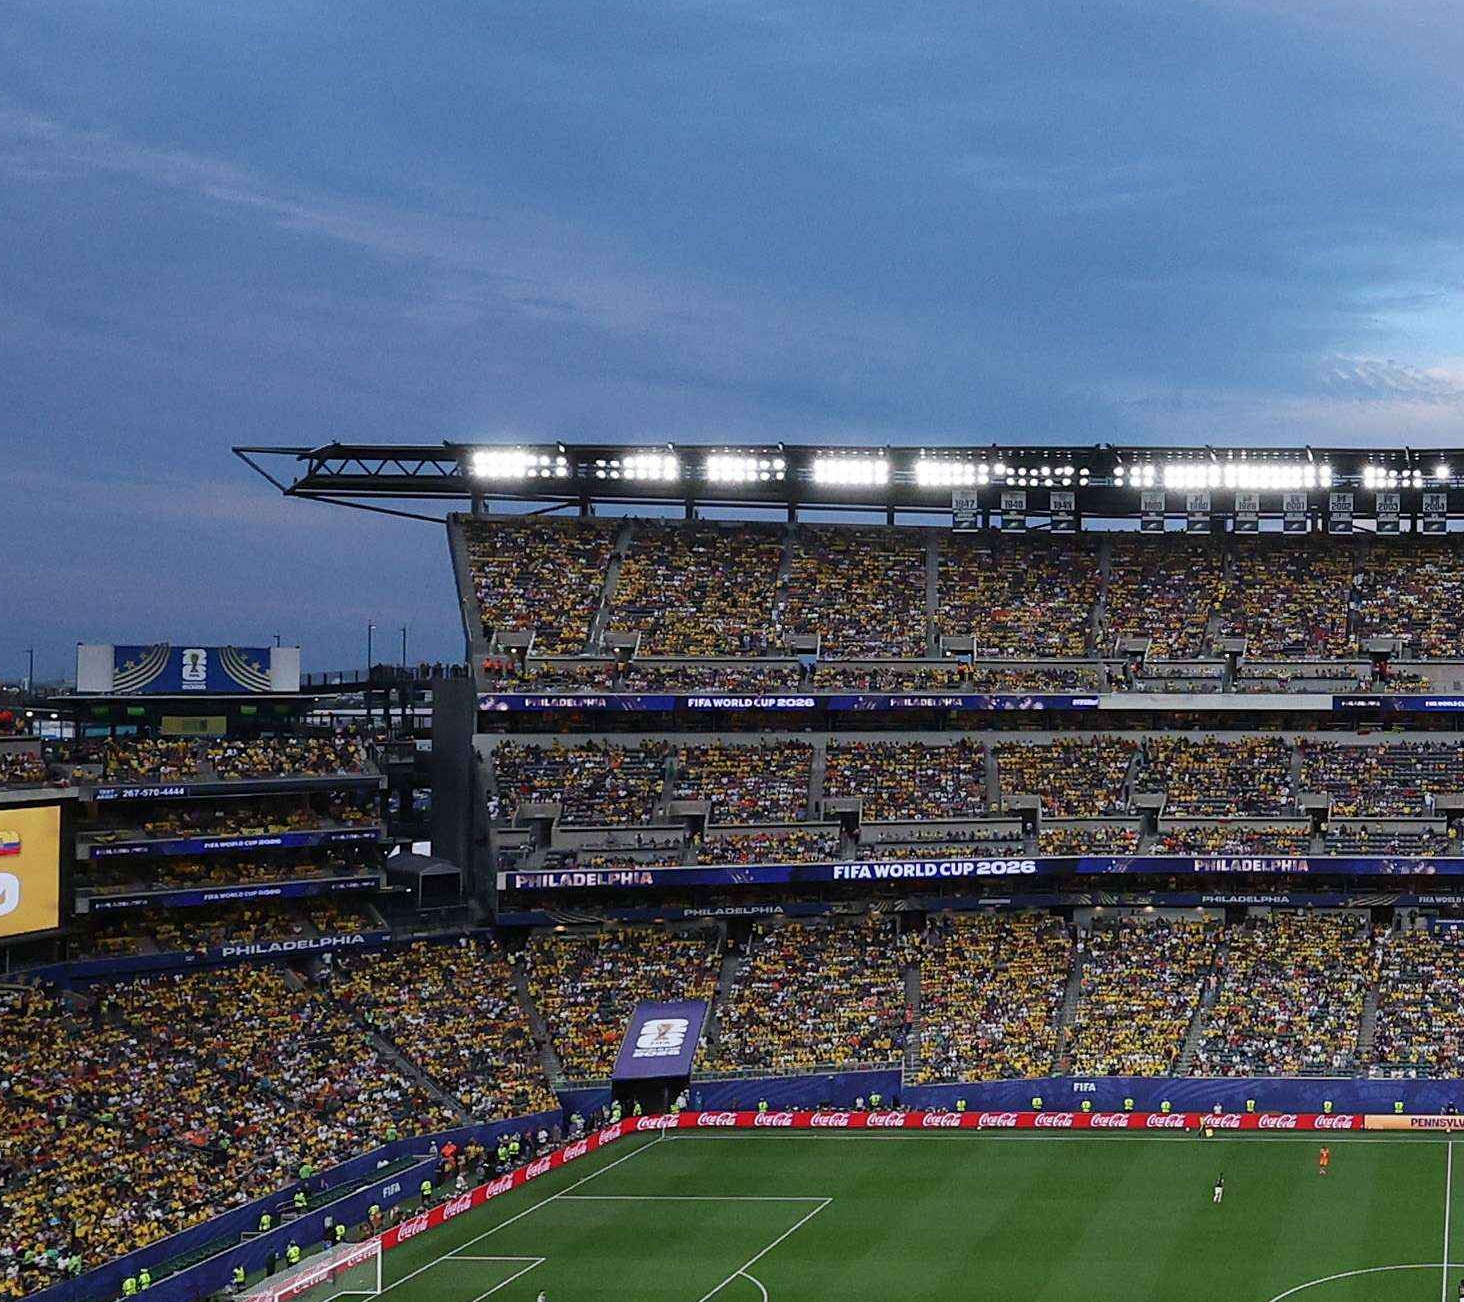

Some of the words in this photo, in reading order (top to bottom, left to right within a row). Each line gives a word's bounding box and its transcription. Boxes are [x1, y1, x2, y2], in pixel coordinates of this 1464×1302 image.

[688, 698, 710, 707] FIFA
[712, 698, 752, 707] WORLD
[754, 698, 775, 707] CUP
[122, 787, 185, 798] 267-570-4444
[834, 865, 872, 879] FIFA
[874, 863, 937, 878] WORLD
[940, 862, 974, 876] CUP
[976, 861, 1036, 875] 2026
[1194, 859, 1309, 872] PHILADELPHIA
[516, 872, 654, 889] PHILADELPHIA
[1202, 895, 1290, 904] PHILADELPHIA
[684, 906, 784, 917] PHILADELPHIA
[222, 934, 365, 957] PHILADELPHIA
[1073, 1082, 1096, 1092] FIFA
[383, 1182, 401, 1199] FIFA
